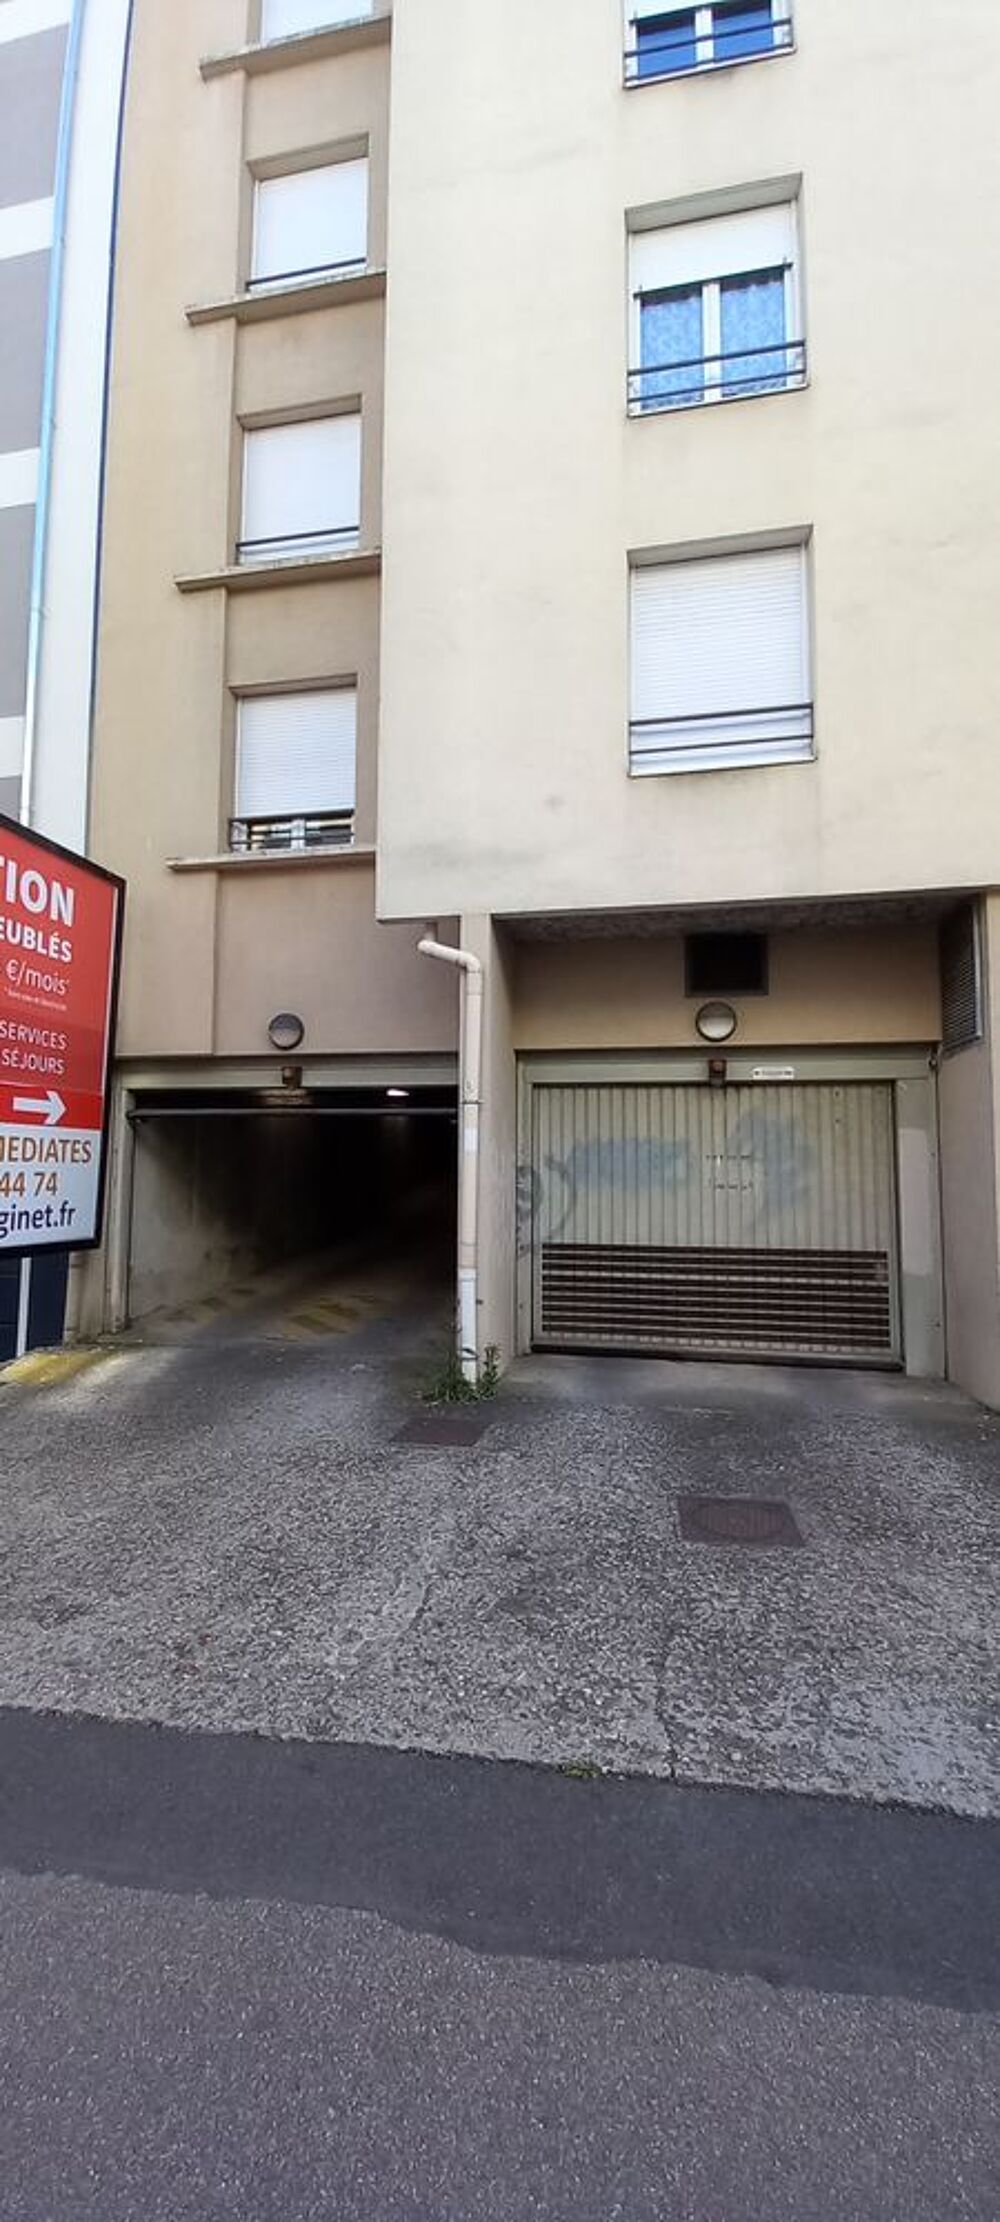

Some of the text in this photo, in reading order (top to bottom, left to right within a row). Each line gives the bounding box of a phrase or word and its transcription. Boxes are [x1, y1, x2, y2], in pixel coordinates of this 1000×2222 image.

[0, 855, 74, 928] ION
[0, 1019, 67, 1050] SERVICES
[2, 1047, 65, 1075] SÉJOURS
[0, 1135, 92, 1164] EDIATES
[34, 1172, 58, 1196] 74
